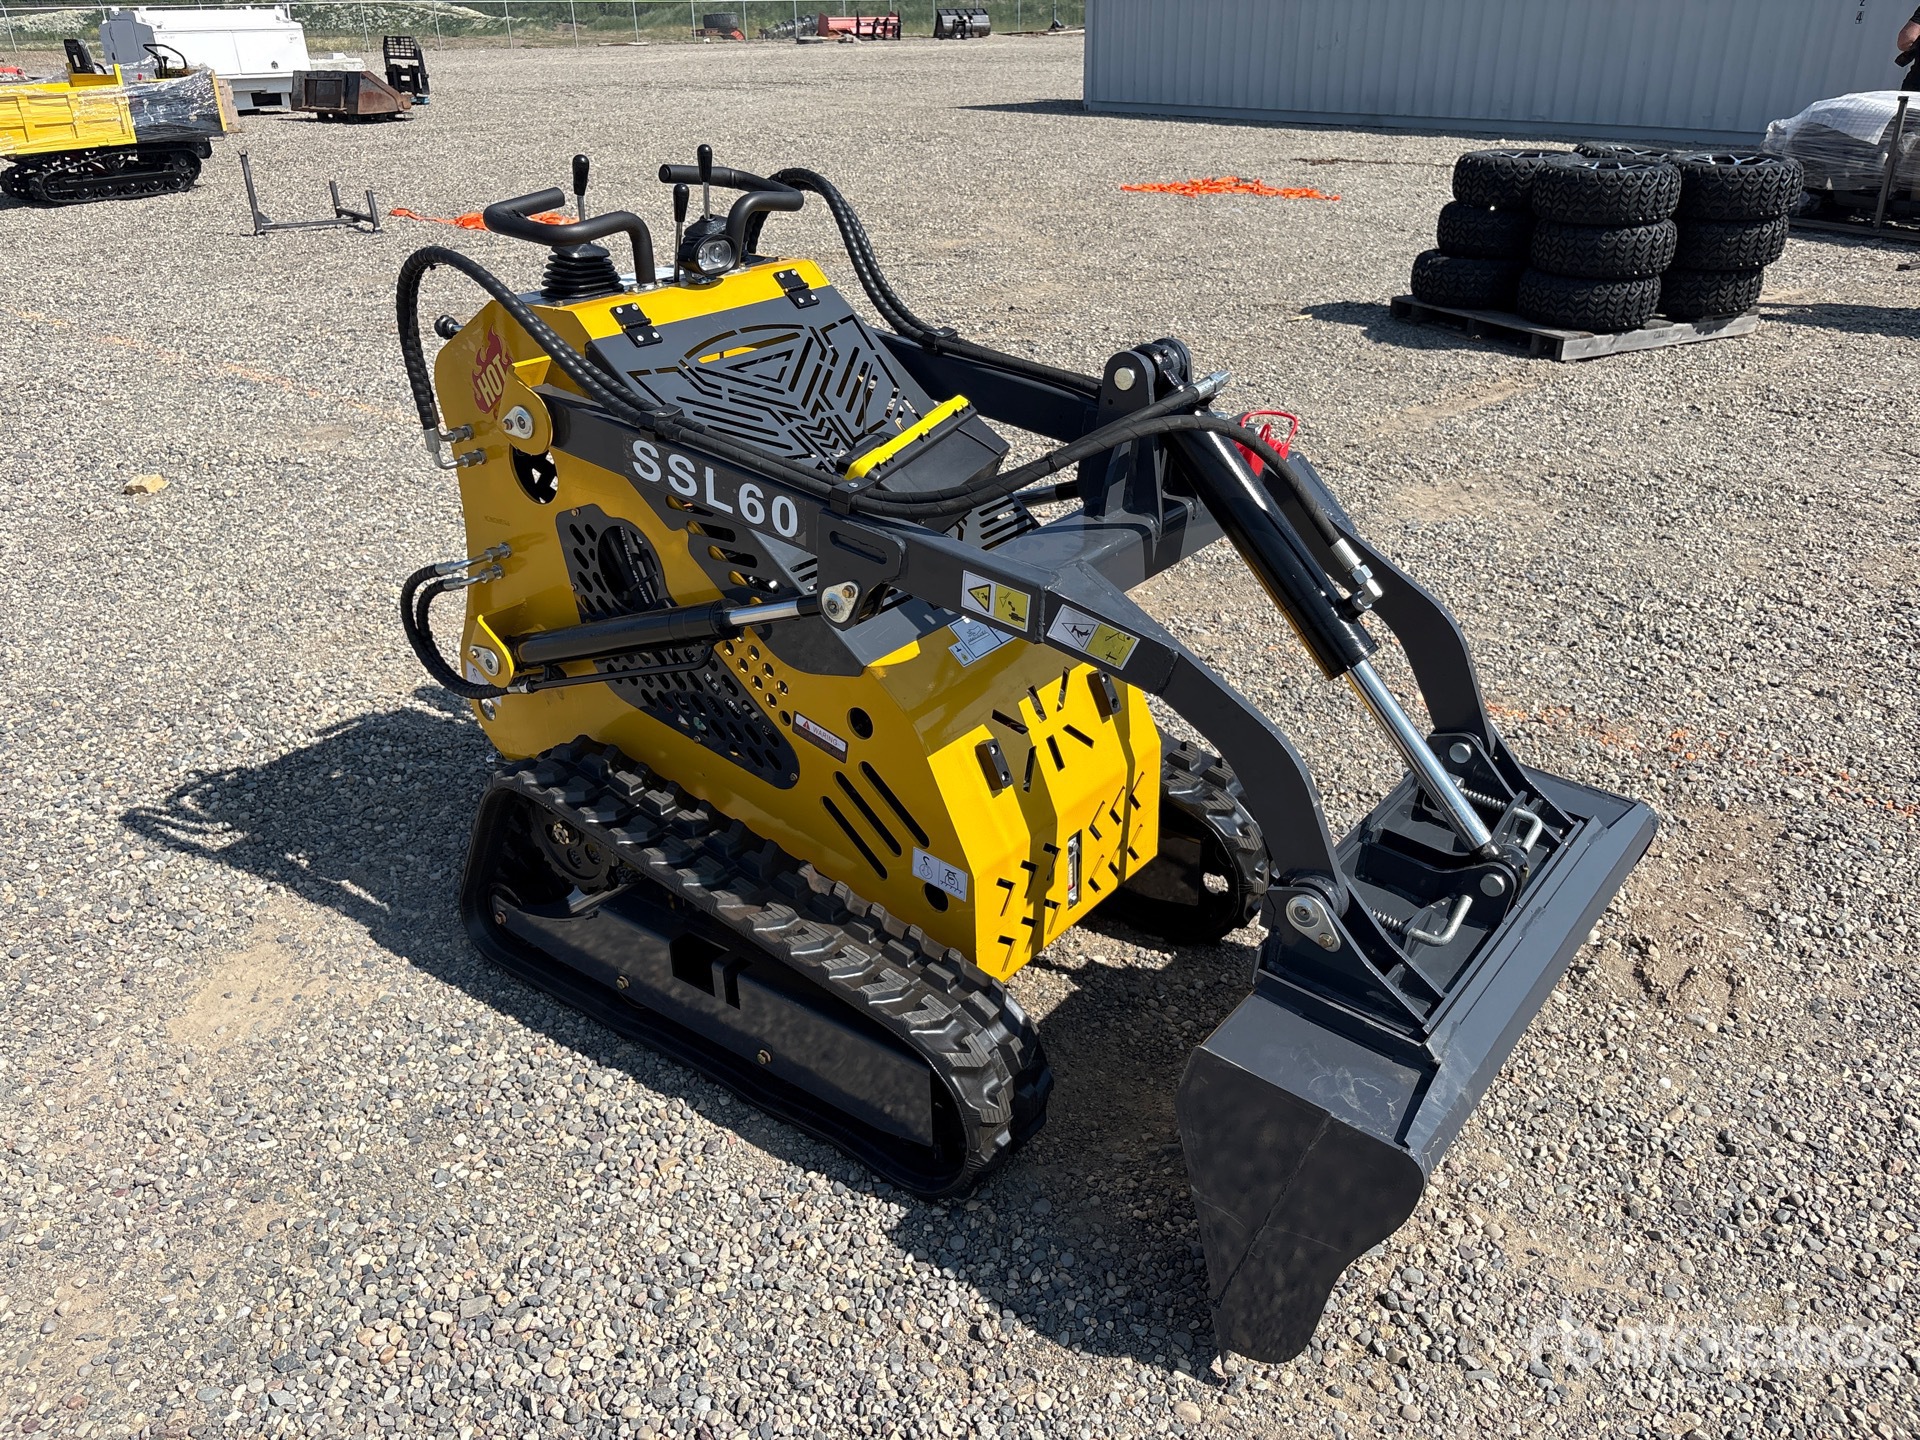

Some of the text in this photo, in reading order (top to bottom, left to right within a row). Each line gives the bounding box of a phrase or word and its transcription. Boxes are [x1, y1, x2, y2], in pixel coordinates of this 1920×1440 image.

[476, 353, 507, 408] HOT
[632, 440, 798, 538] SSL60
[812, 725, 838, 746] WARING
